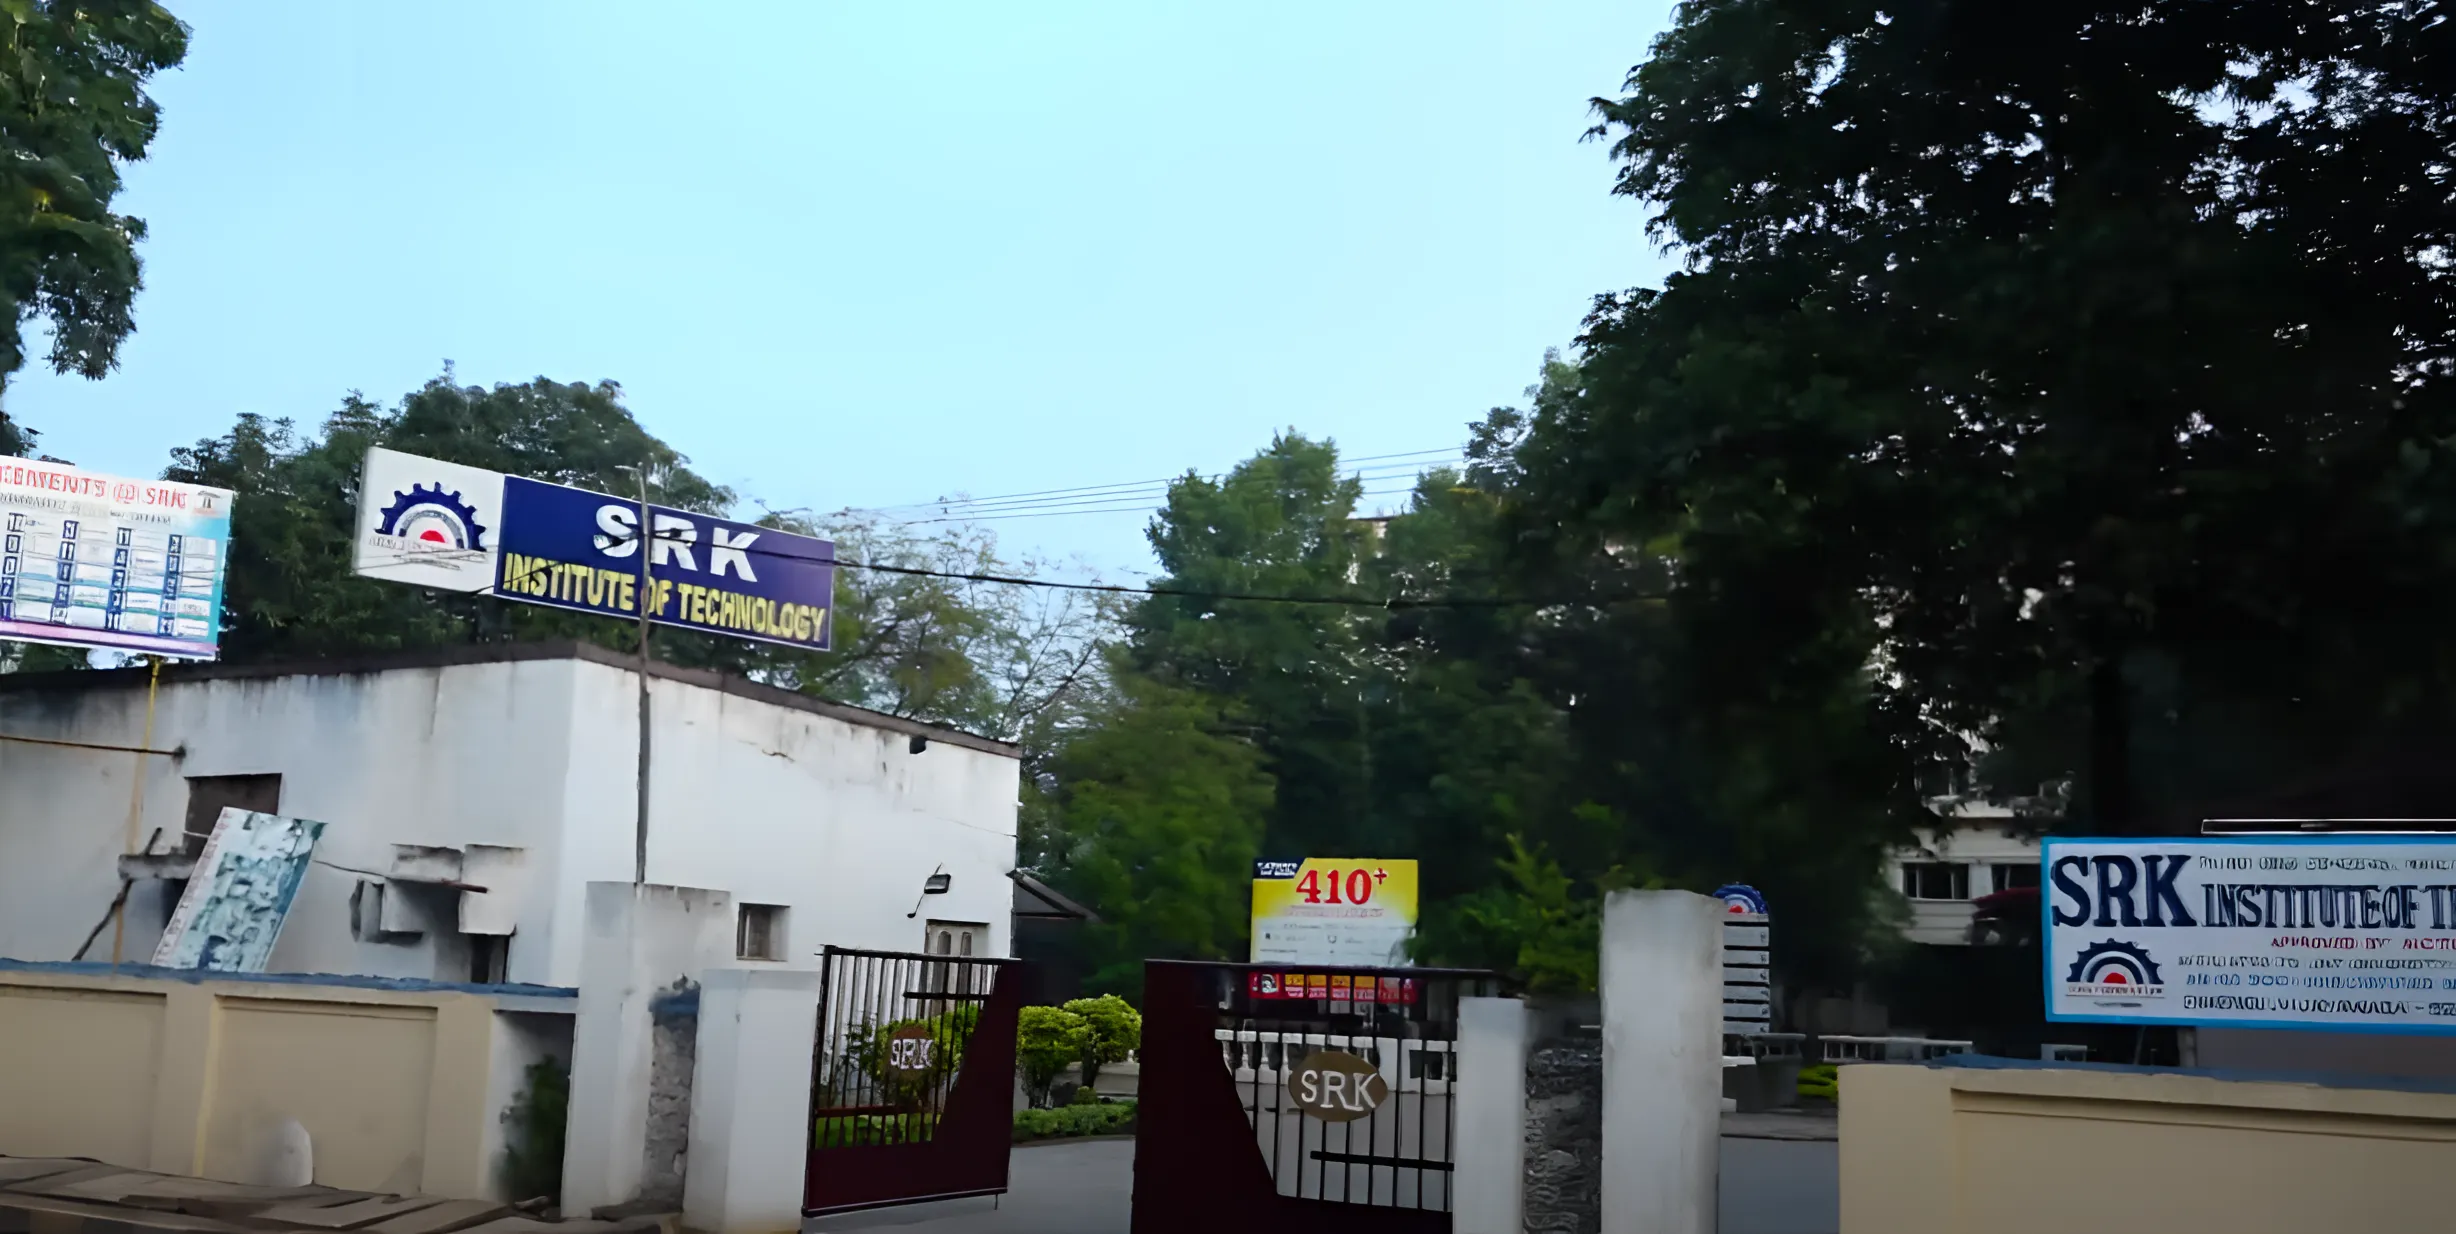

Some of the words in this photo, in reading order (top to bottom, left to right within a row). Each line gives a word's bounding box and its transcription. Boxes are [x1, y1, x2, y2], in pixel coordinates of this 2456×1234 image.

[593, 504, 760, 583] SRK
[503, 552, 635, 612] INSTITUTE
[677, 582, 826, 643] TECHNOLOGY
[2050, 854, 2197, 928] SRK
[2201, 883, 2382, 928] INSTITUTE
[2383, 884, 2420, 929] OF
[1301, 1069, 1378, 1112] SRK
